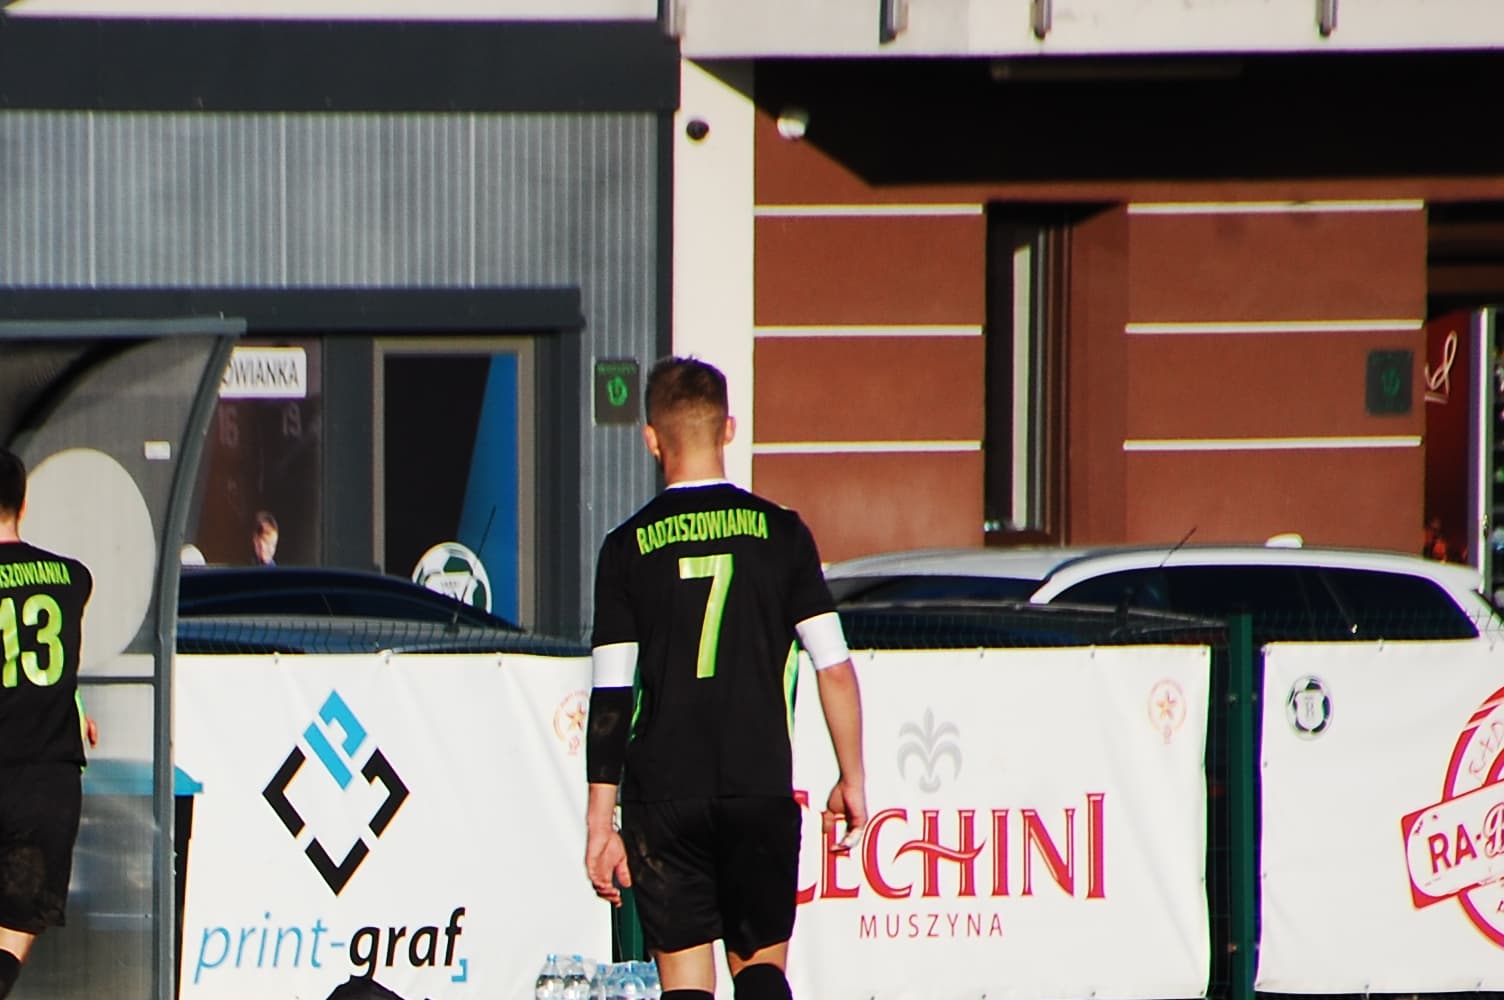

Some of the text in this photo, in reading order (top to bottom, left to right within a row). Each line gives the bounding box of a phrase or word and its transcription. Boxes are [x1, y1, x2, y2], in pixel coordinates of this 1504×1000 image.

[636, 507, 769, 555] RADZISZOWIANKA
[678, 553, 735, 679] 7
[793, 790, 1106, 906] ECHINI
[193, 906, 466, 985] print-graf
[859, 911, 1003, 939] MUSZYNA
